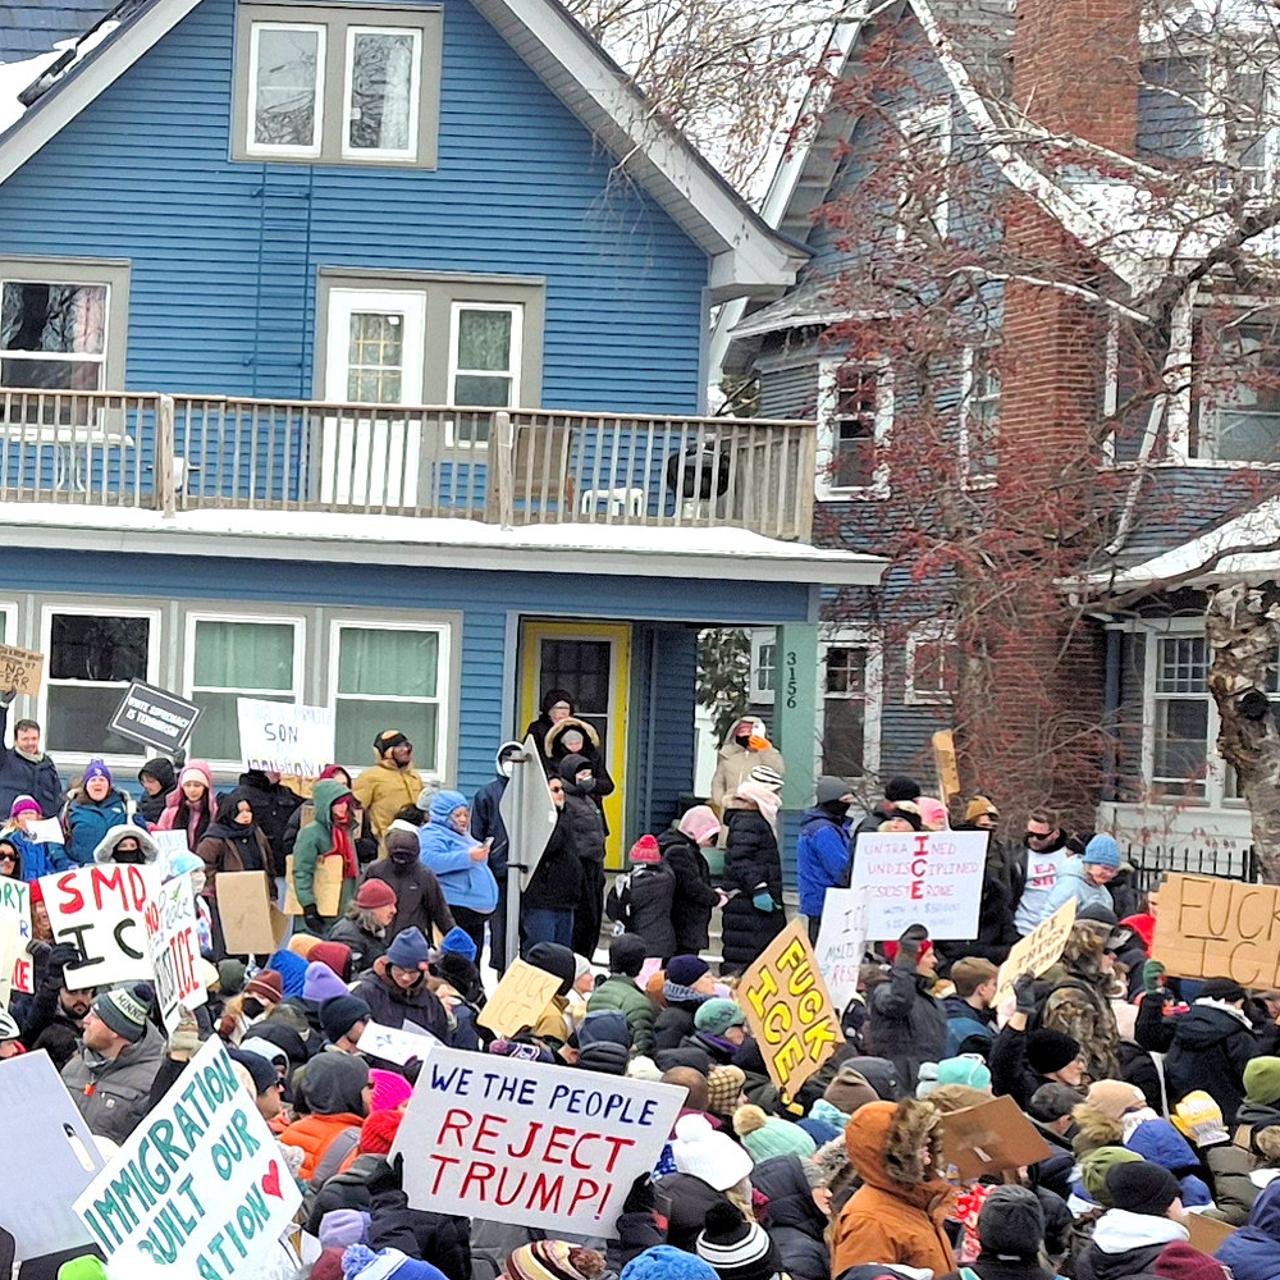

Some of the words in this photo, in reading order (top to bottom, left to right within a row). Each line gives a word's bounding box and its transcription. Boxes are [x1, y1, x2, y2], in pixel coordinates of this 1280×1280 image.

[5, 662, 25, 676] NO
[787, 651, 797, 709] 3156
[264, 722, 298, 744] SON
[57, 864, 147, 915] SMD
[1178, 877, 1280, 942] FUCK
[58, 918, 145, 970] IC
[775, 936, 837, 1063] FUCK
[430, 1063, 473, 1095] WE
[483, 1073, 538, 1105] THE
[548, 1084, 659, 1126] PEOPLE
[83, 1048, 239, 1255] IMMIGRATION
[211, 1108, 261, 1181] OUR
[436, 1108, 636, 1174] REJECT
[429, 1153, 613, 1220] TRUMP!
